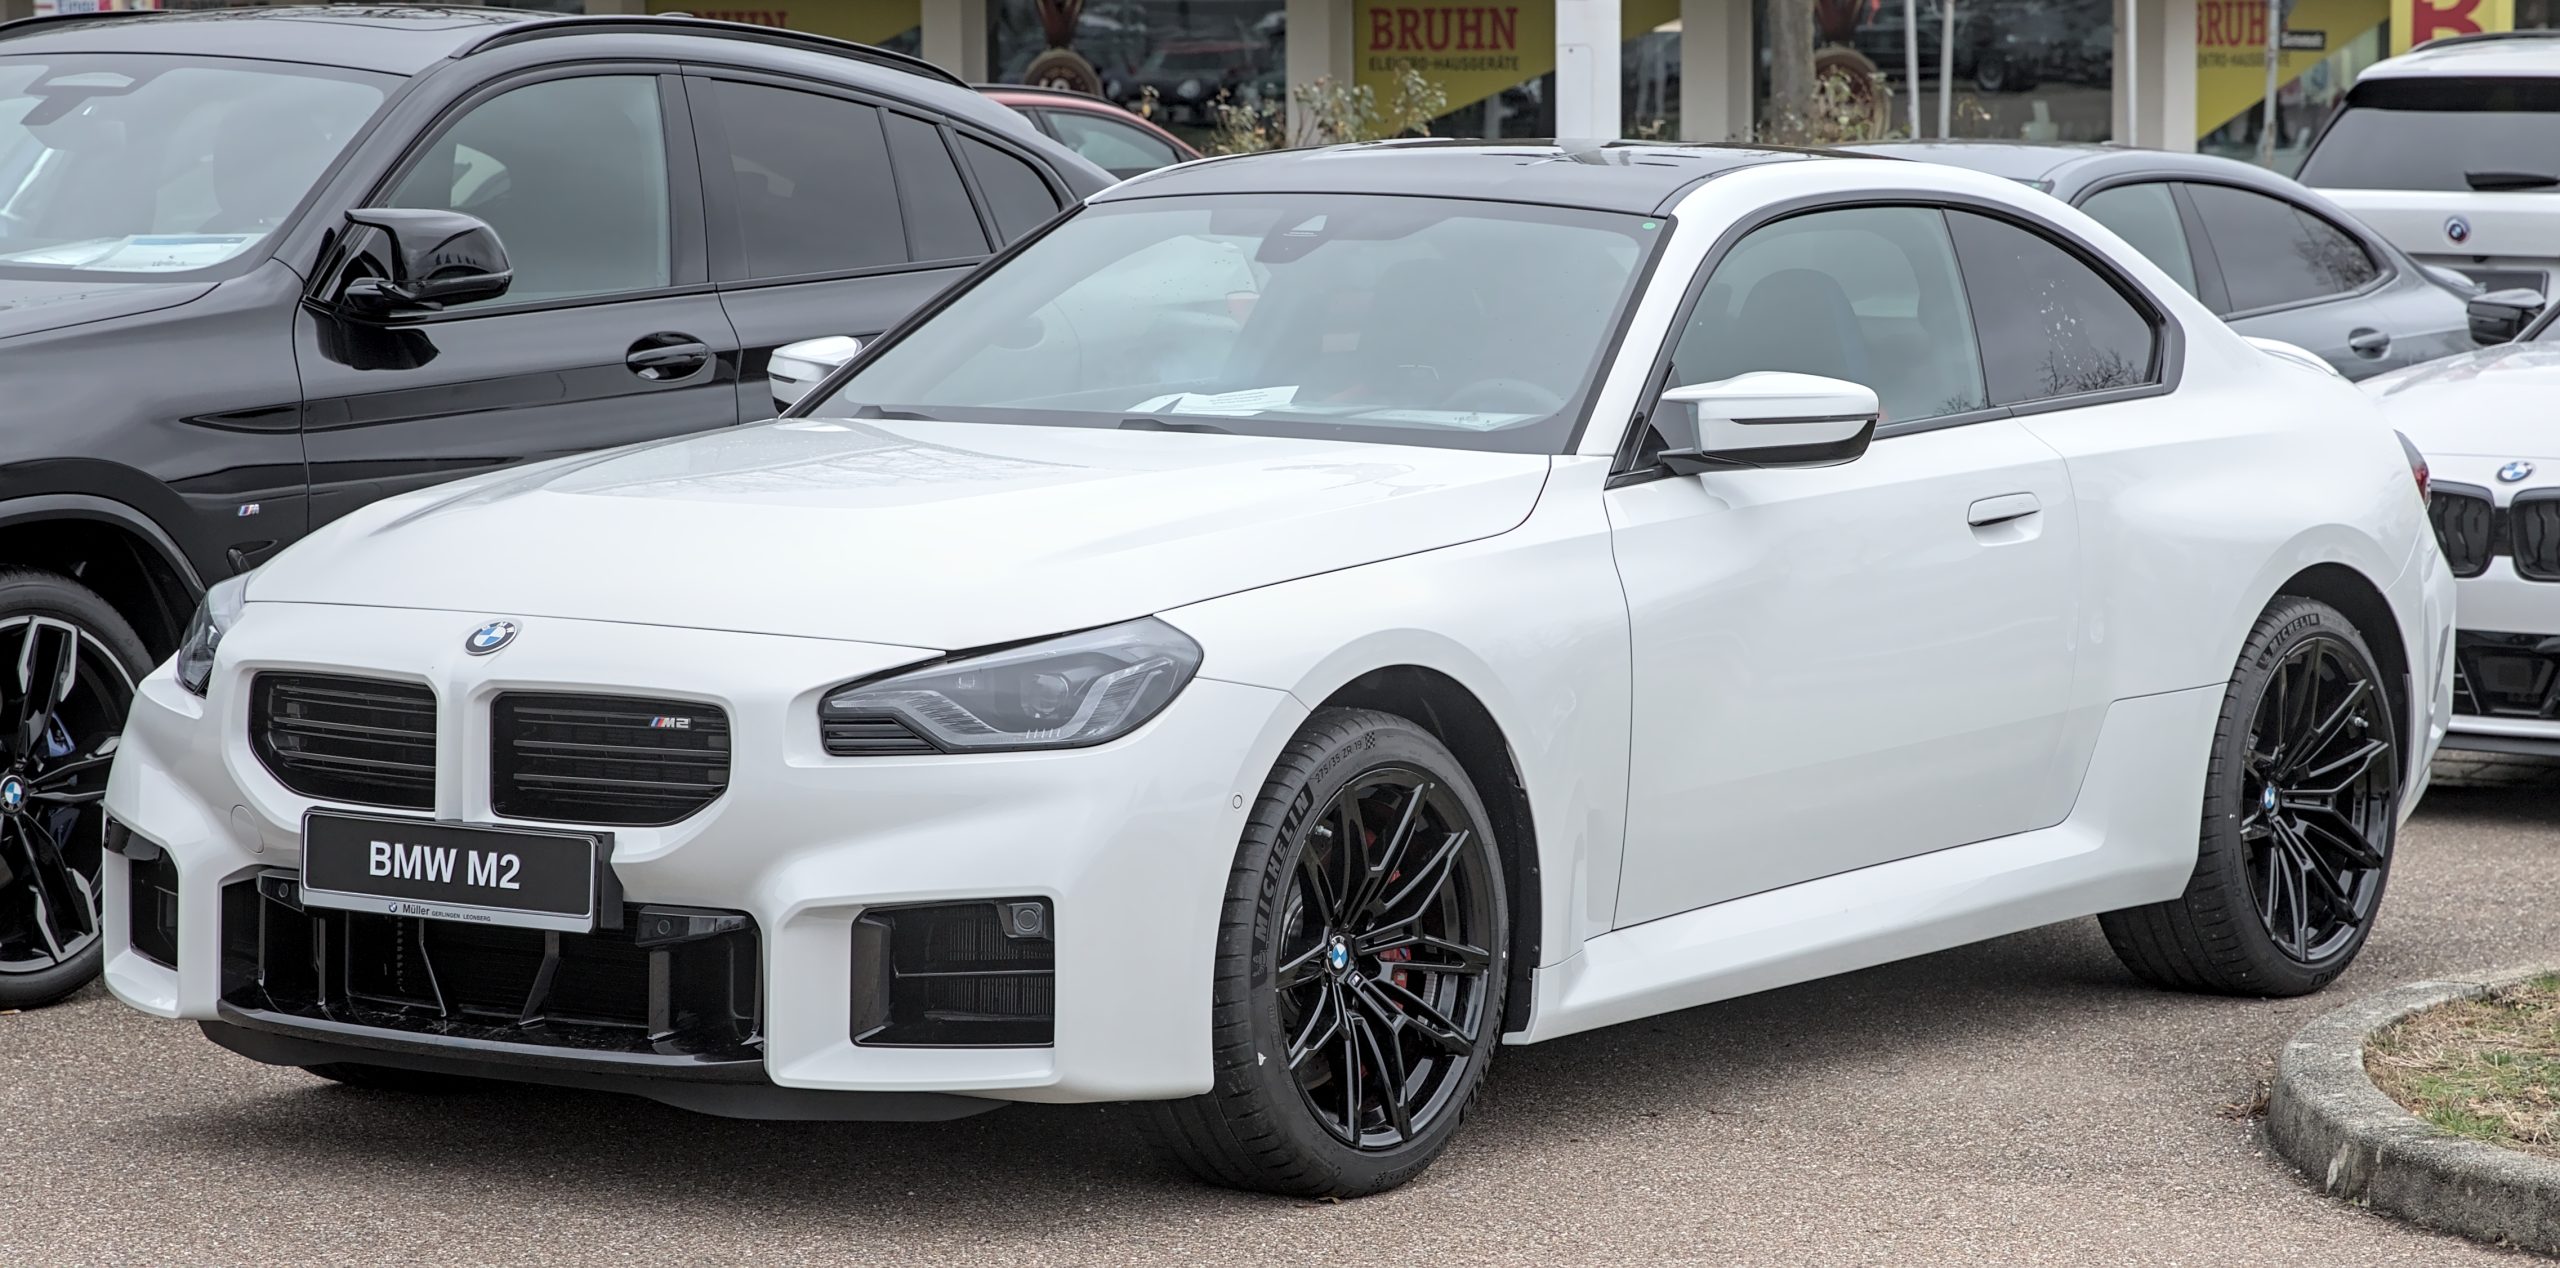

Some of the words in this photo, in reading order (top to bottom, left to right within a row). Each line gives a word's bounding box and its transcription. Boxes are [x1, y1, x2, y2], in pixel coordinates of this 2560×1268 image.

[1369, 7, 1519, 51] BRUHN
[2196, 0, 2288, 48] RUH
[2269, 613, 2319, 655] MICHELIN
[660, 717, 689, 729] M2
[1314, 754, 1341, 784] 275/35
[1342, 745, 1353, 759] ZR
[1353, 739, 1363, 751] 19
[369, 840, 458, 884] BMW
[467, 850, 521, 890] M2
[1254, 791, 1310, 943] MICHELIN
[402, 903, 430, 916] Müller
[431, 910, 461, 919] GERLINGEN
[462, 913, 492, 922] LEONBERG
